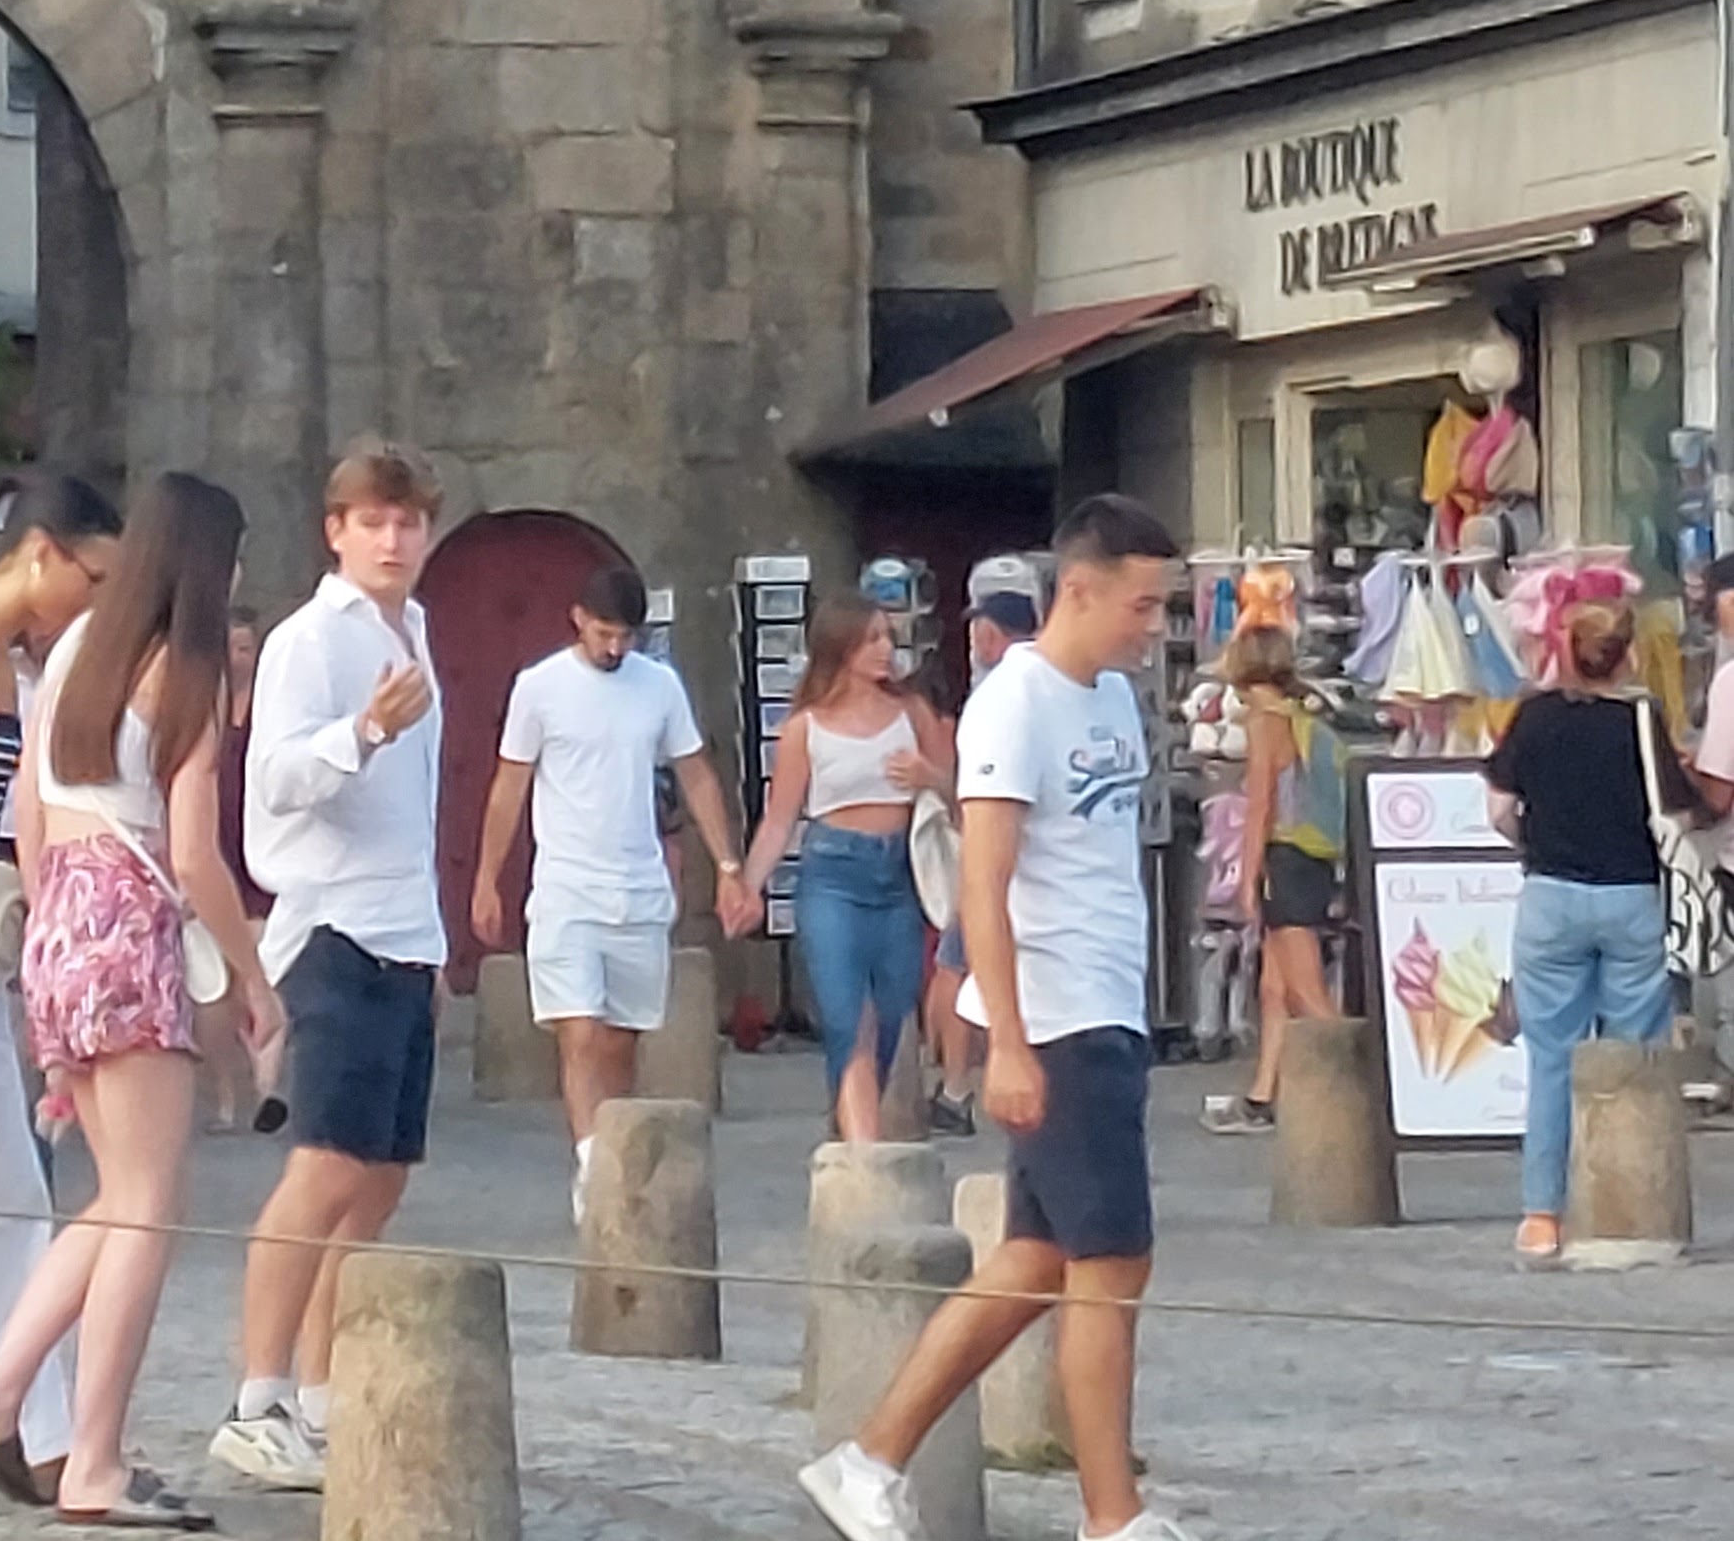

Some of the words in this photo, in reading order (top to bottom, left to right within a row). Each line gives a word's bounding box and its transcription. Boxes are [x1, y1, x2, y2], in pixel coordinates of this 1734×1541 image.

[1245, 147, 1277, 212] LA
[1280, 116, 1403, 208] BOUTIQUE
[1280, 225, 1312, 296] DE
